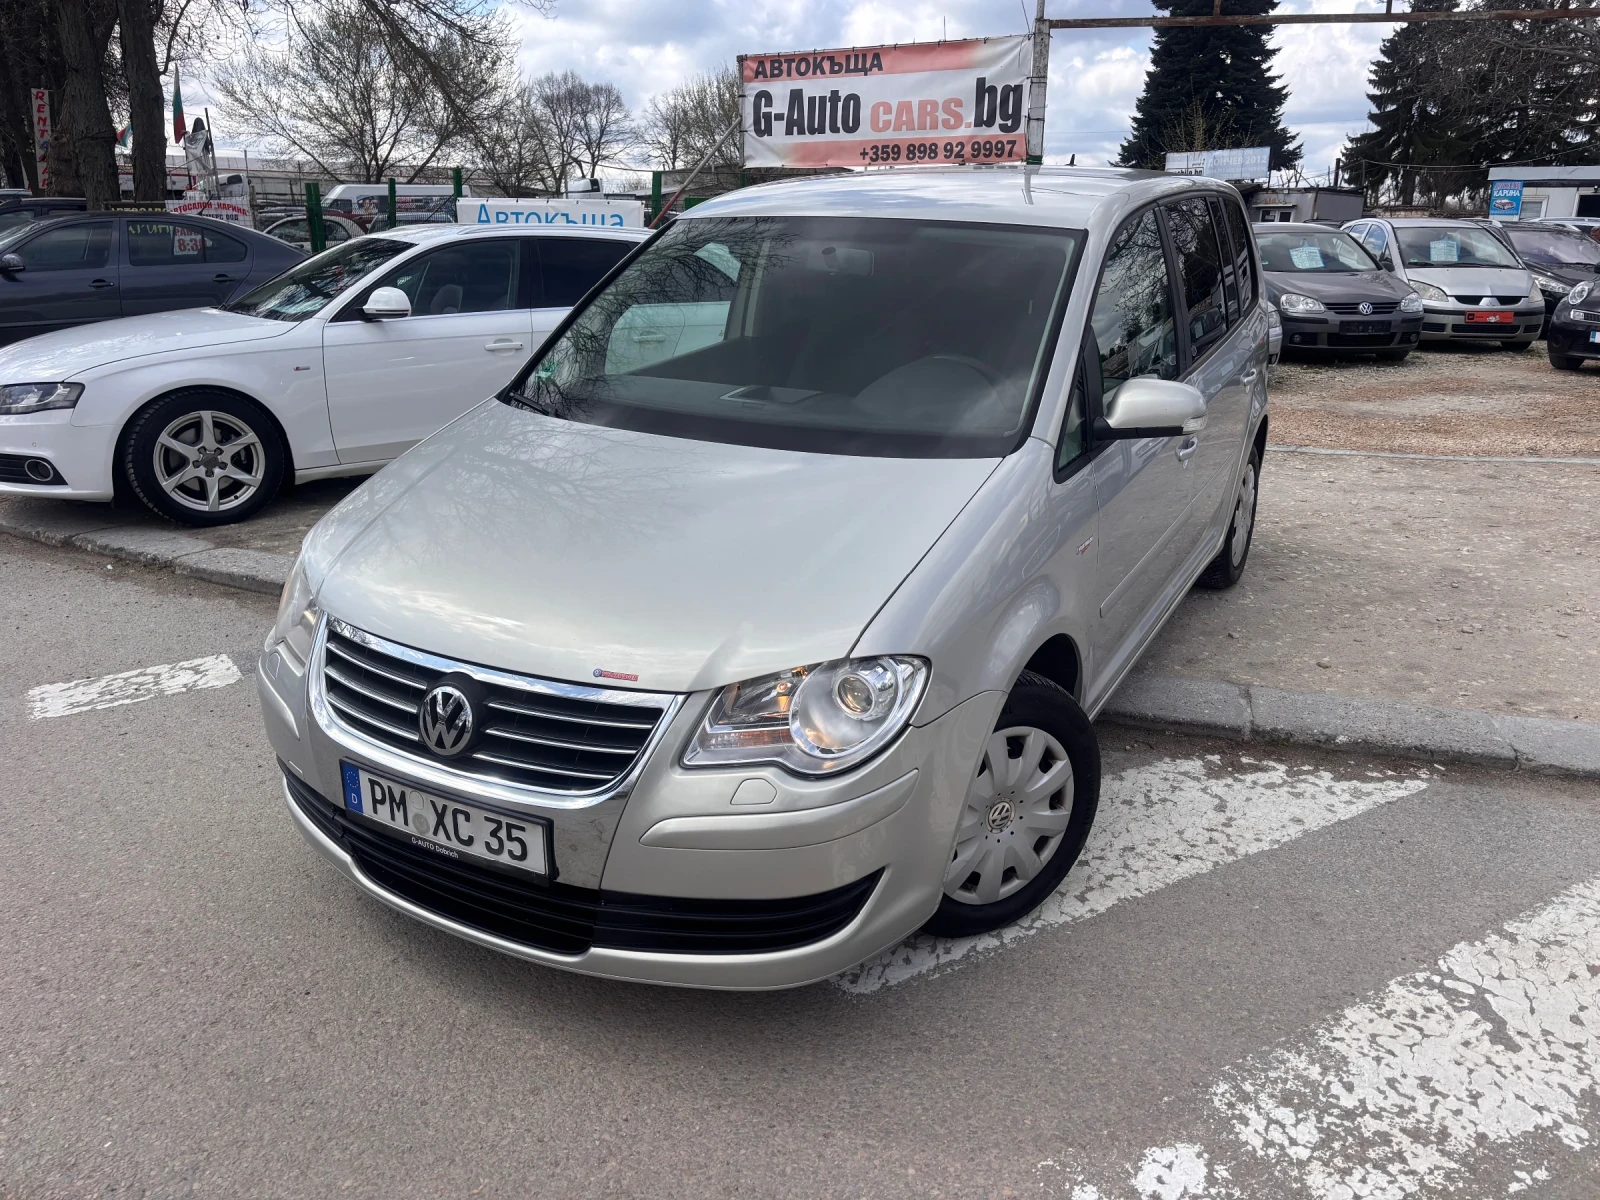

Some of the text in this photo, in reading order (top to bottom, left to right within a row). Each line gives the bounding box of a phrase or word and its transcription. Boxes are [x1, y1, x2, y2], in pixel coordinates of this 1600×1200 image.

[754, 52, 883, 79] АВТОКЪЩА
[35, 91, 48, 138] RENT
[753, 89, 861, 137] G-Auto
[860, 140, 1017, 162] +359 898 92 9997
[1245, 155, 1267, 164] 2012
[171, 202, 212, 213] ВТОСАЛОН
[351, 793, 358, 804] D
[368, 777, 528, 862] PM XC 35
[435, 845, 459, 859] Dobrich
